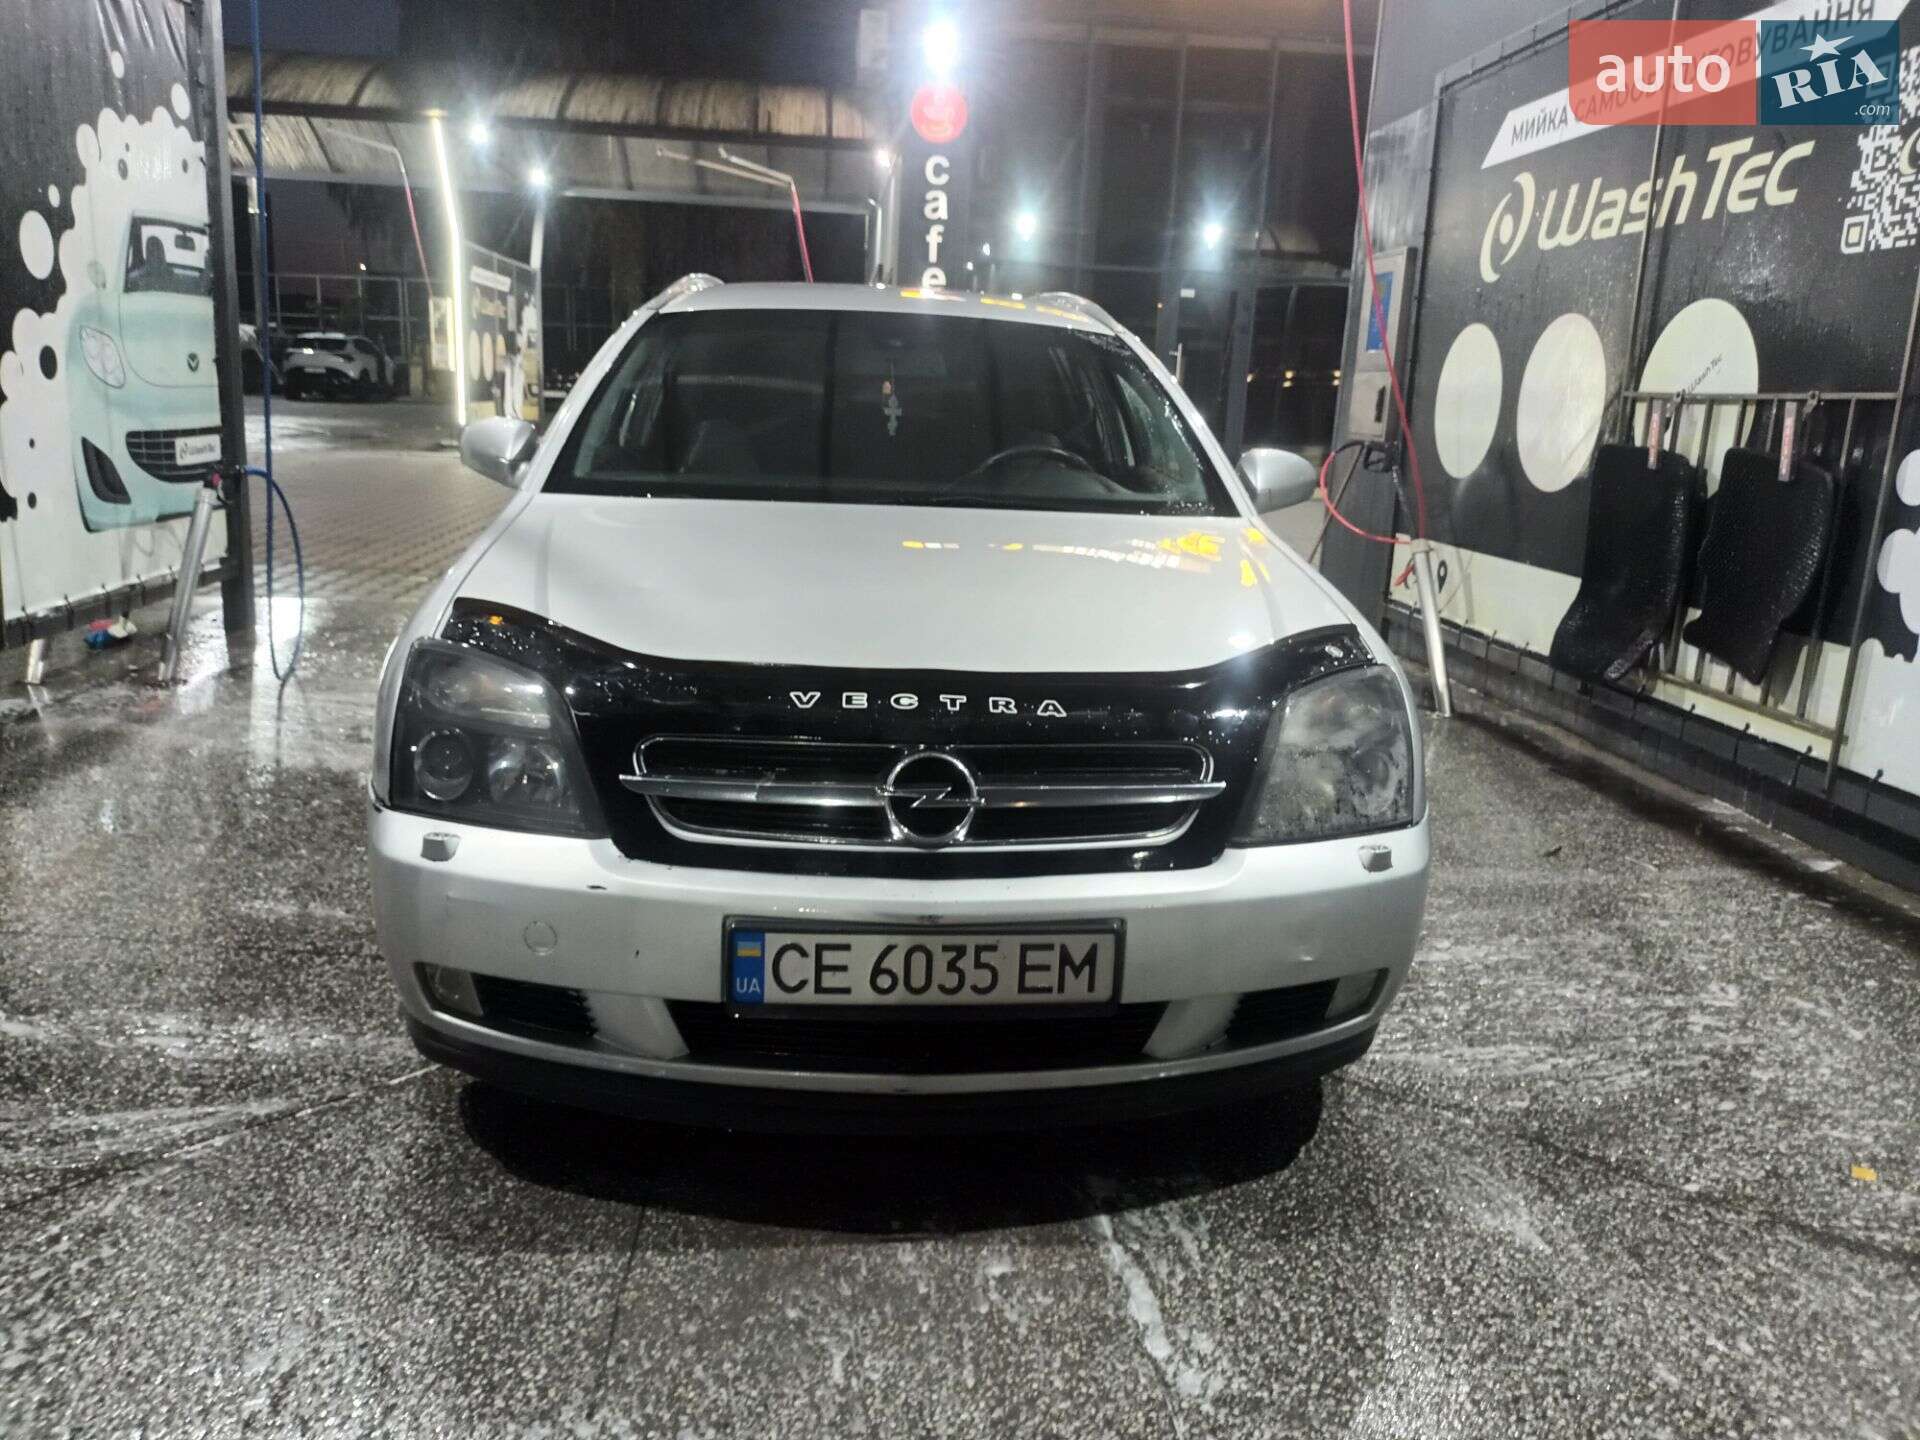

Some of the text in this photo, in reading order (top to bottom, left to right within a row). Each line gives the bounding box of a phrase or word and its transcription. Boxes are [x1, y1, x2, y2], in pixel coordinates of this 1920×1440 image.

[1512, 104, 1568, 147] МИЙКА
[921, 154, 950, 290] cafe
[789, 691, 1067, 717] VECTRA
[736, 977, 761, 993] UA
[771, 942, 1098, 995] CE 6035 EM
